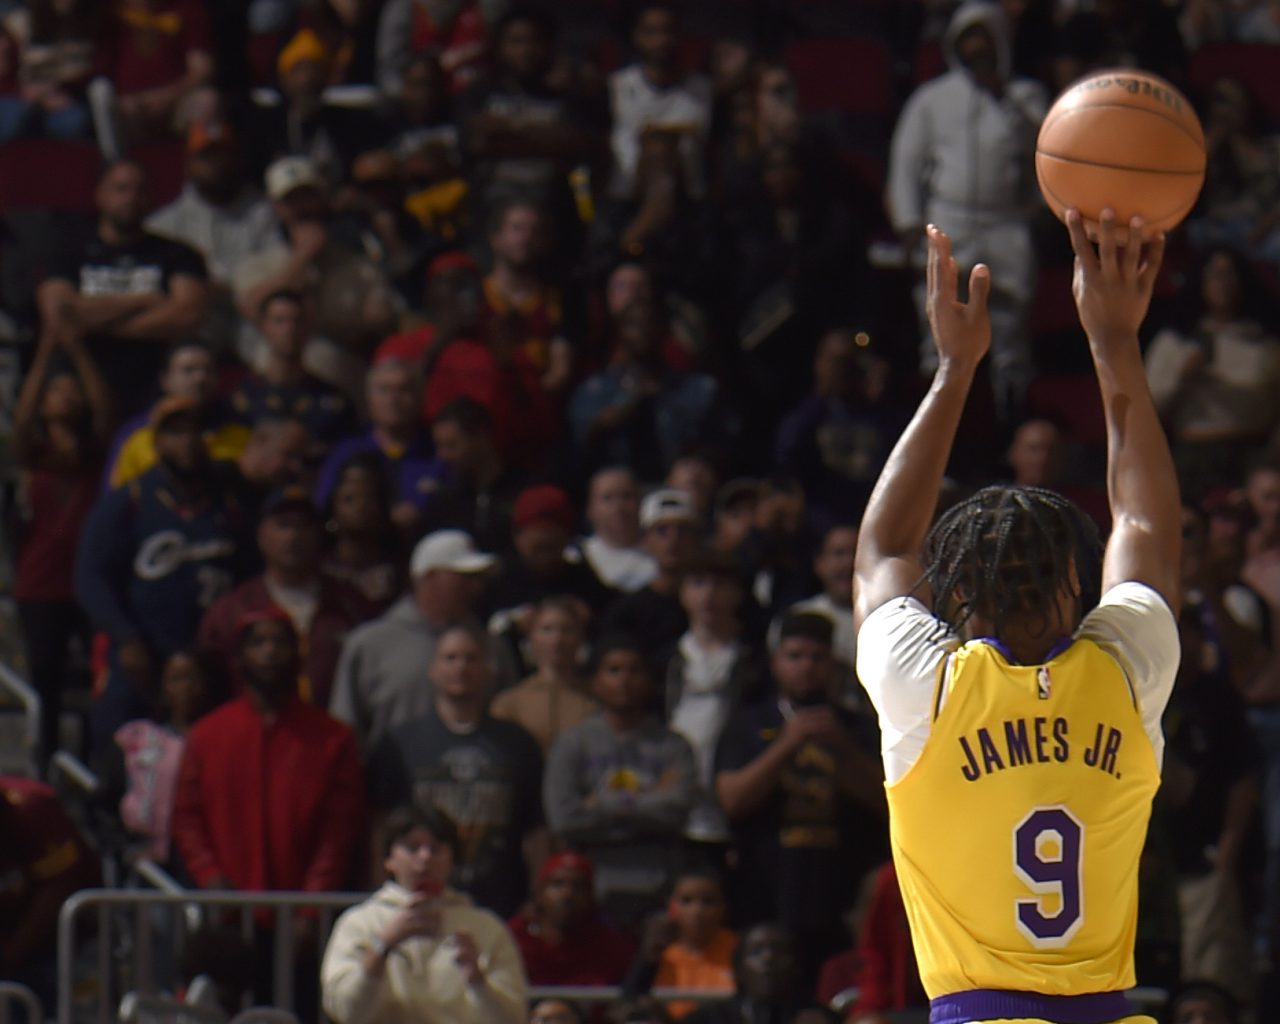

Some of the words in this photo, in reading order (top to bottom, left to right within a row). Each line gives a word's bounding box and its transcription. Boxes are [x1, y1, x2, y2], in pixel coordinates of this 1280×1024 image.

[958, 717, 1069, 782] JAMES
[1083, 723, 1122, 779] JR.
[1013, 803, 1084, 949] 9
